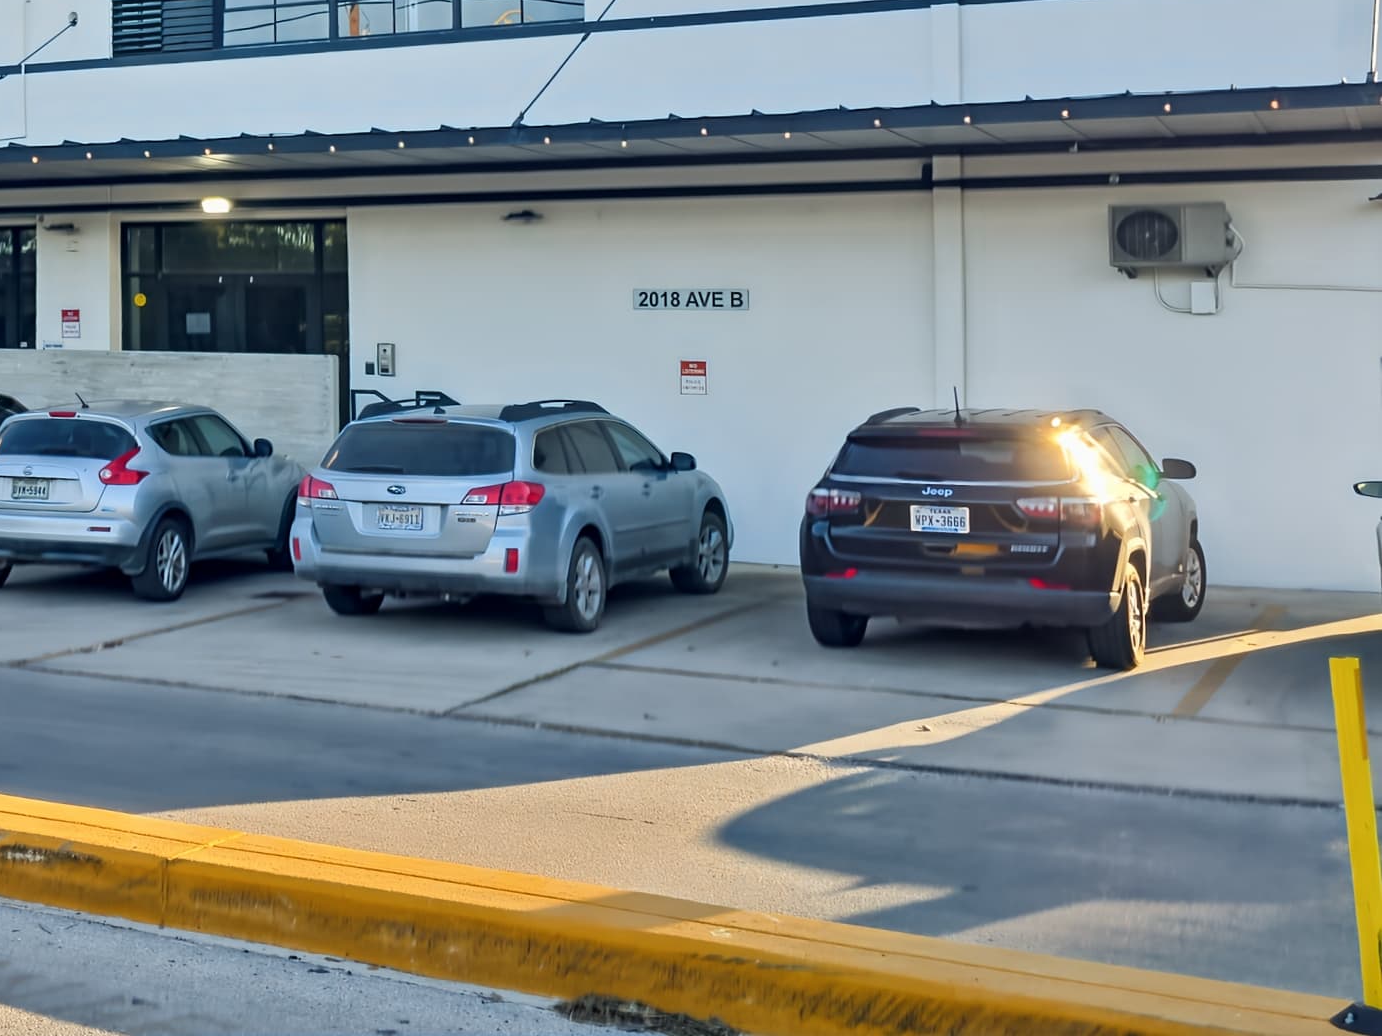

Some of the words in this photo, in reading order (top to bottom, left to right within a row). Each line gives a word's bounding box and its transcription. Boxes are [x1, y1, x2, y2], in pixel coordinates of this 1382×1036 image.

[638, 291, 681, 308] 2018
[685, 291, 724, 308] AVE
[730, 291, 744, 308] B
[921, 487, 954, 498] Jeep
